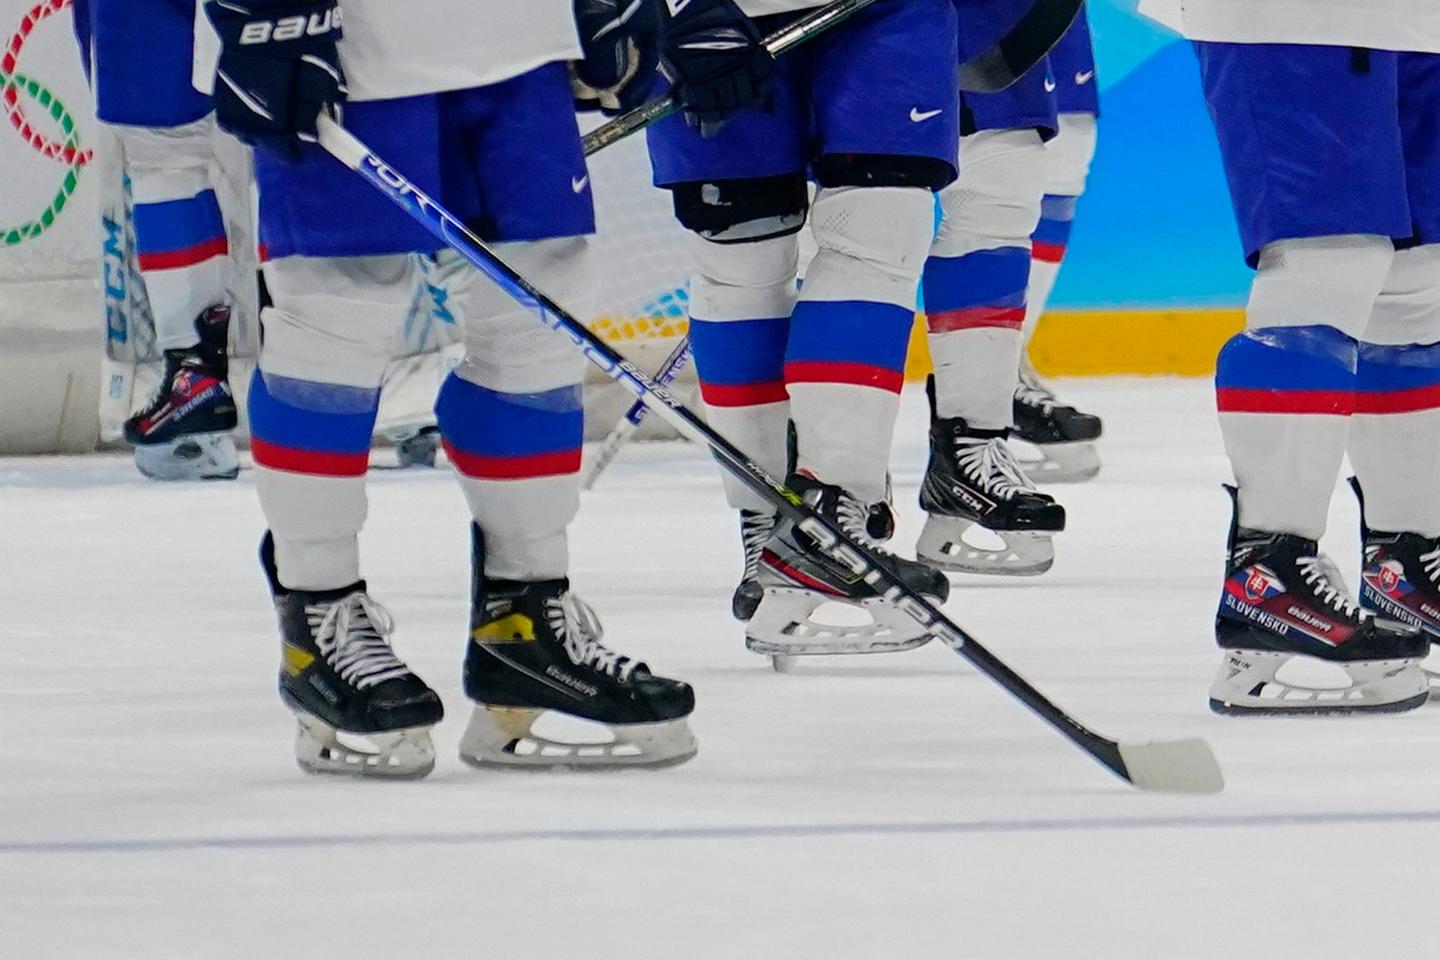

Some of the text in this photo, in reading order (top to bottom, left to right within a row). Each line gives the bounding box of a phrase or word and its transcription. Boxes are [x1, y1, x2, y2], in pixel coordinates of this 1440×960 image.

[102, 212, 128, 344] CCM
[953, 486, 983, 510] CCM
[1225, 594, 1289, 636] SLOVENSKO
[1364, 585, 1423, 628] SLOVENSKO
